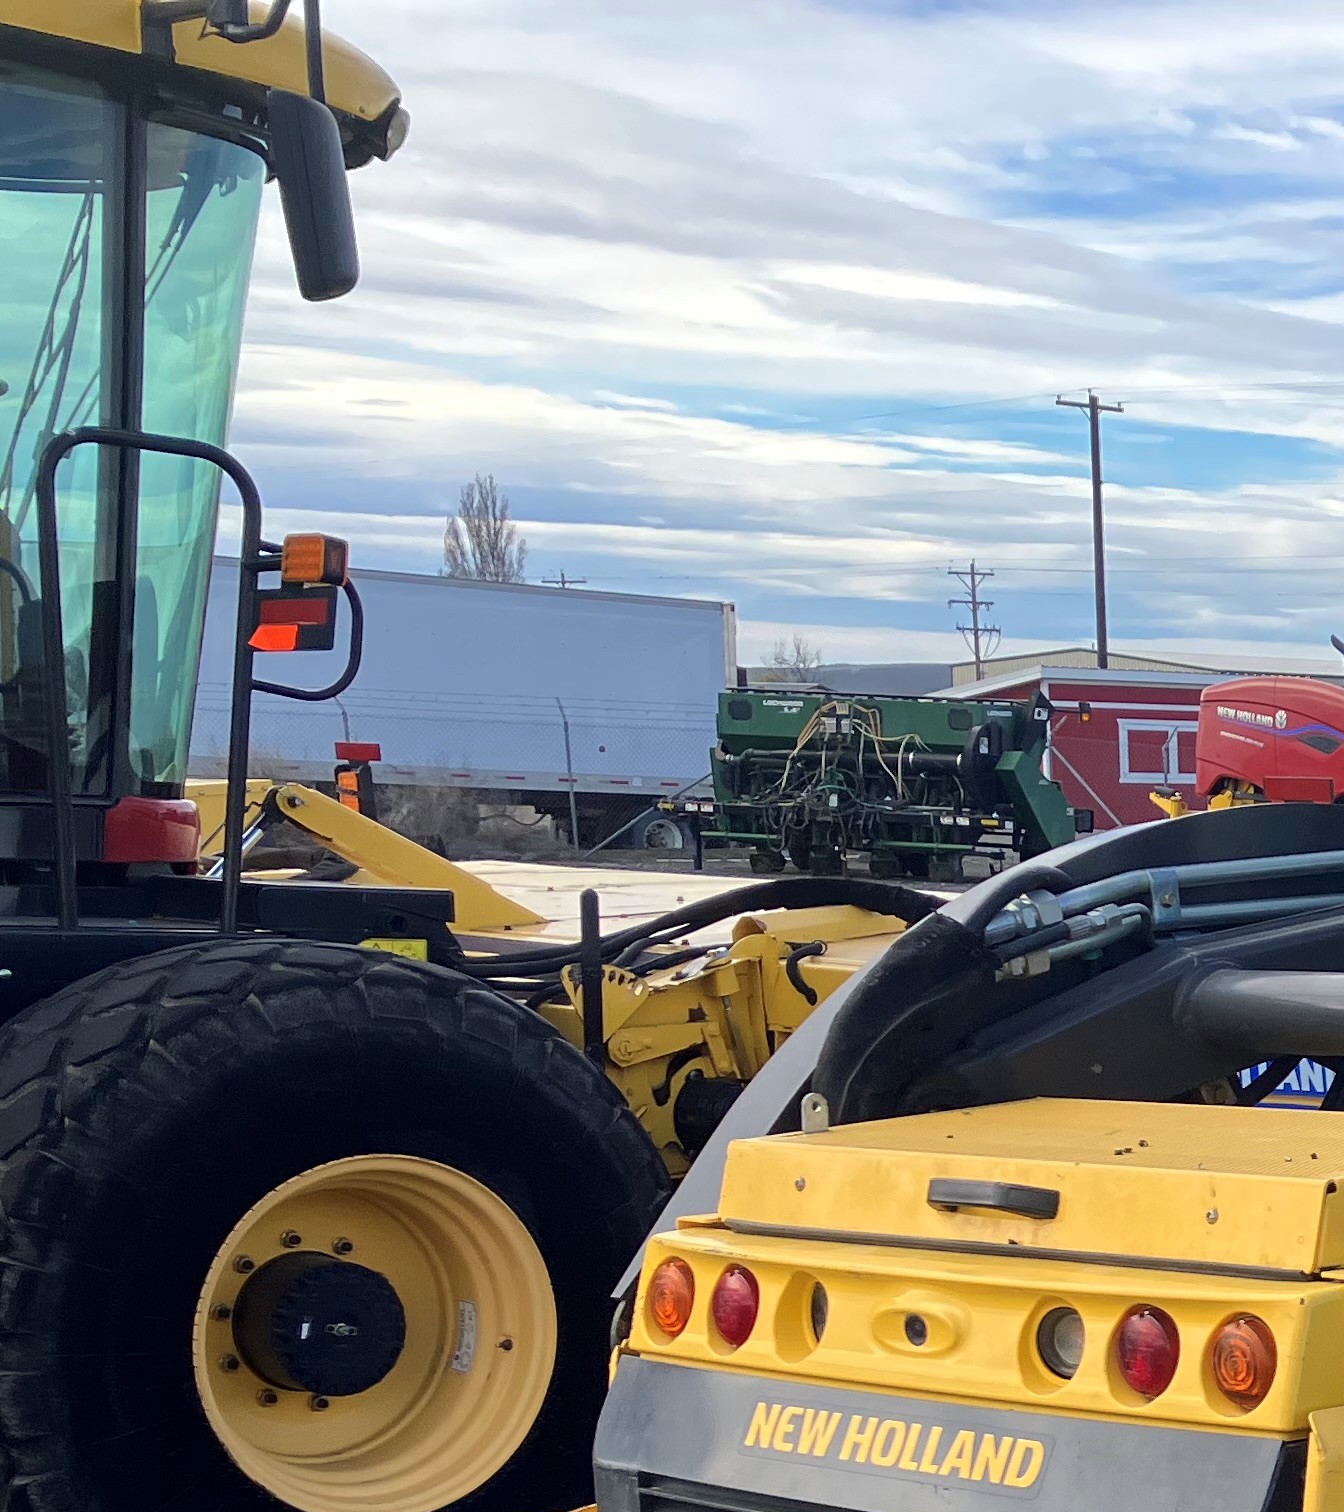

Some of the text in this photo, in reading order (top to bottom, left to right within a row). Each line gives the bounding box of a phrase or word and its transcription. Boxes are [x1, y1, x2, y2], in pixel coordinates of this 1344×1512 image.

[1217, 706, 1274, 727] NEW HOLLAND
[744, 1402, 1045, 1489] NEW HOLLAND
